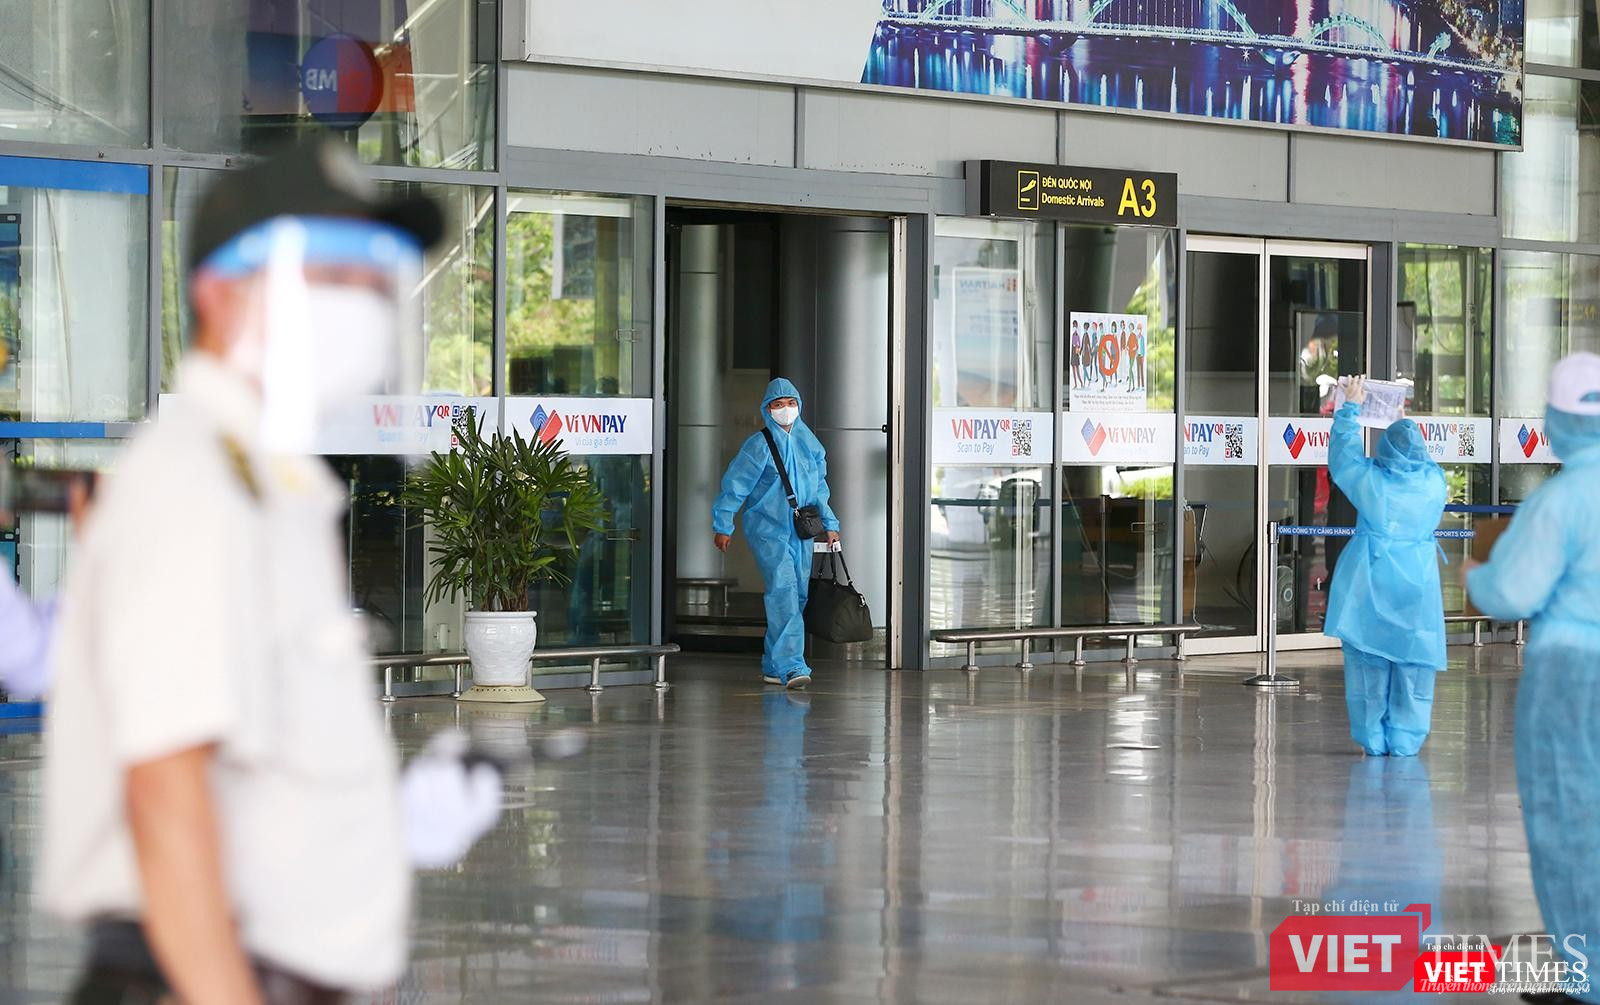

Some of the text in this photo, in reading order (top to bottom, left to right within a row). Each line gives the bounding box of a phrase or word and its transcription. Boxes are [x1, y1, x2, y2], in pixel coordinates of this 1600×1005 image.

[1041, 192, 1105, 207] Domestic Arrivals
[1117, 177, 1157, 217] A3
[581, 415, 627, 433] VNPAY
[1121, 427, 1156, 443] VNPAY
[957, 442, 995, 455] Scan to Pay
[1199, 444, 1210, 457] Pay
